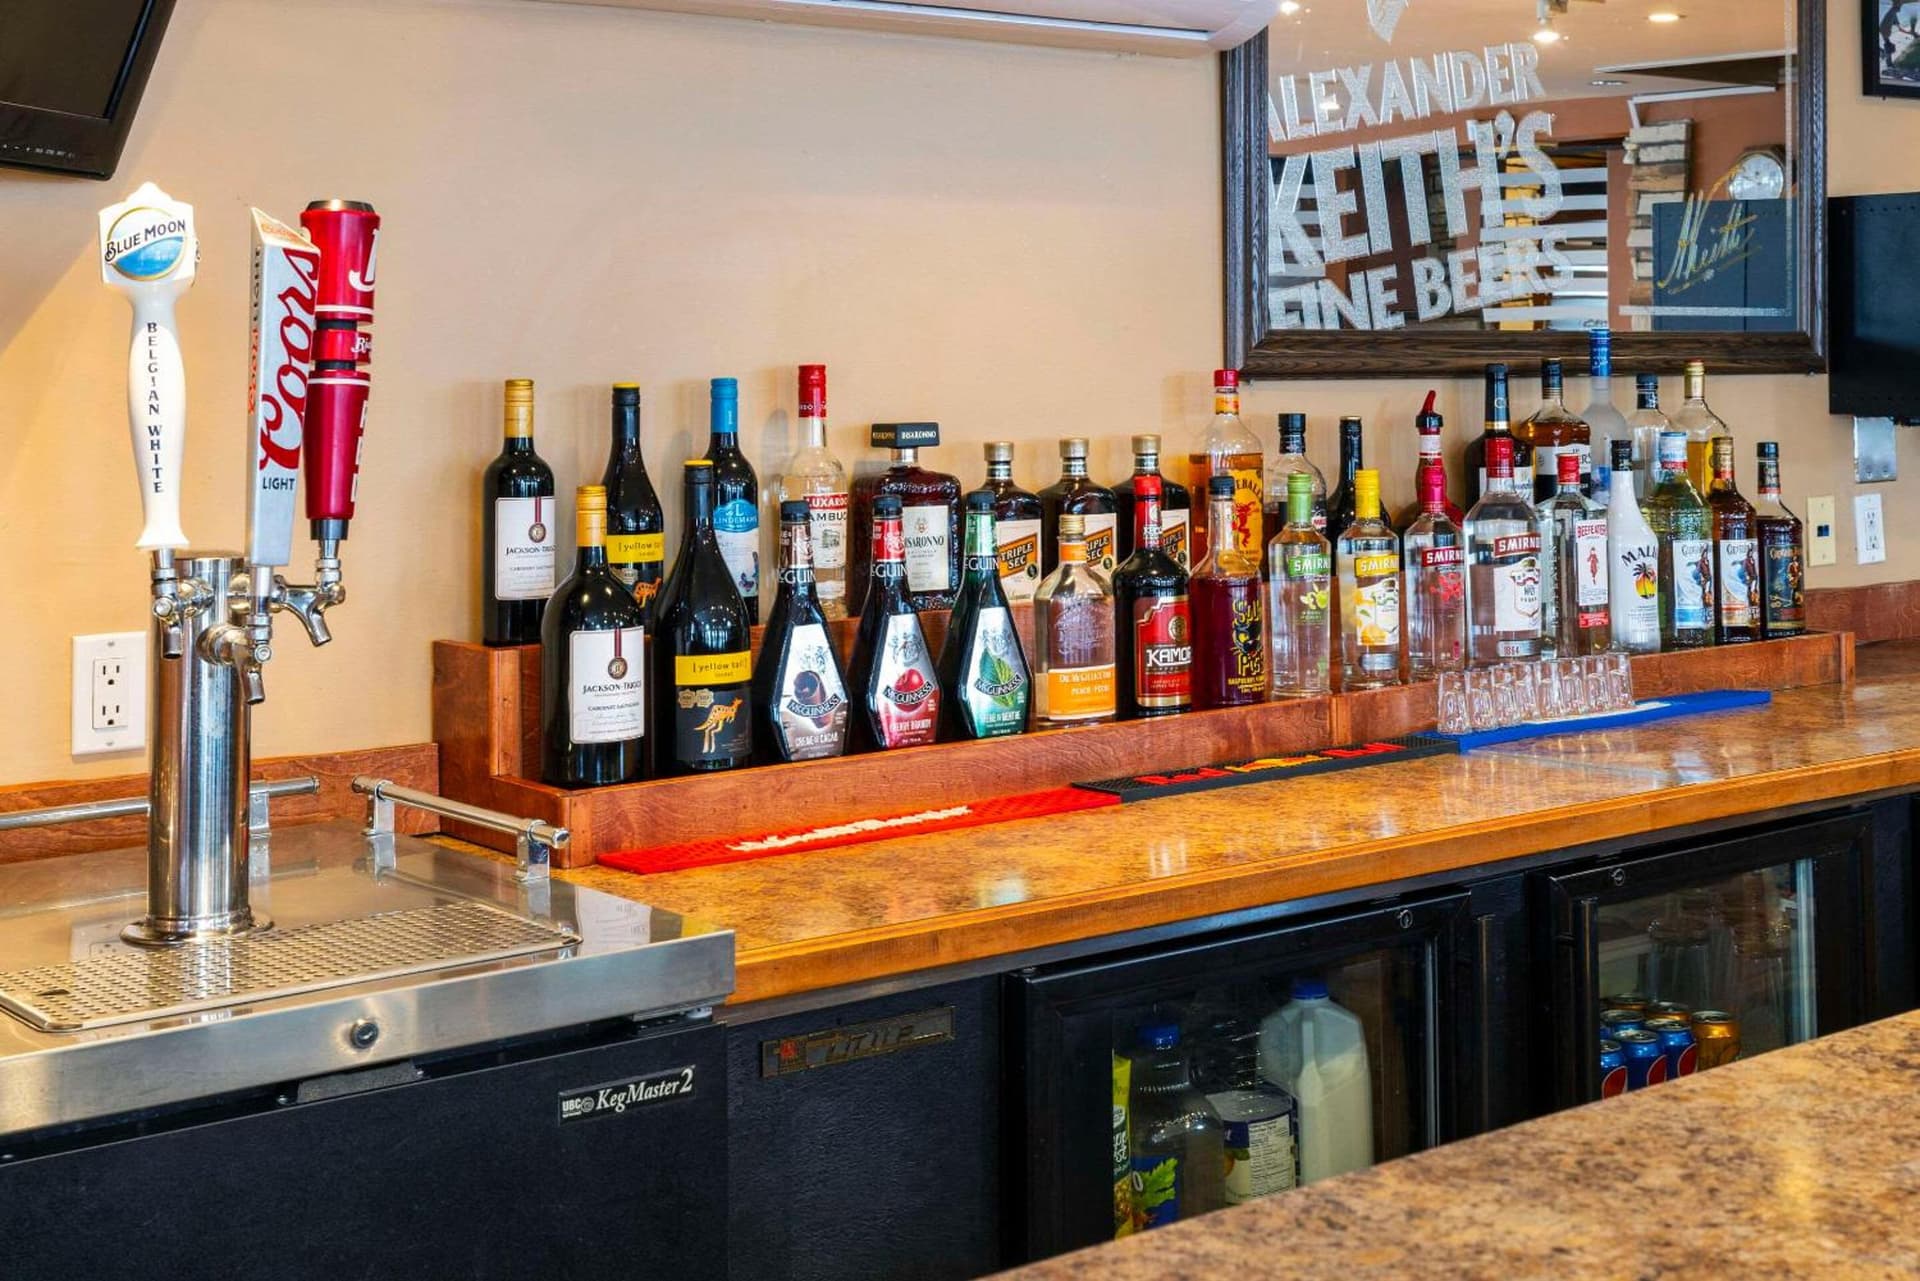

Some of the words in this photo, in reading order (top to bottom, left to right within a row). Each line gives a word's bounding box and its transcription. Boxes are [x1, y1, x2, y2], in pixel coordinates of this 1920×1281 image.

[1268, 110, 1563, 274] KEITH'S
[104, 232, 142, 262] BLUE
[144, 219, 187, 242] MOON
[1412, 229, 1574, 322] BEERS
[146, 322, 161, 416] BELGIAN
[259, 248, 321, 471] Coors
[147, 424, 163, 494] WHITE
[262, 477, 295, 491] LIGHT
[999, 541, 1034, 562] TRIPLE
[1007, 556, 1027, 571] SEC
[562, 1098, 582, 1112] UBC
[680, 1068, 694, 1093] 2
